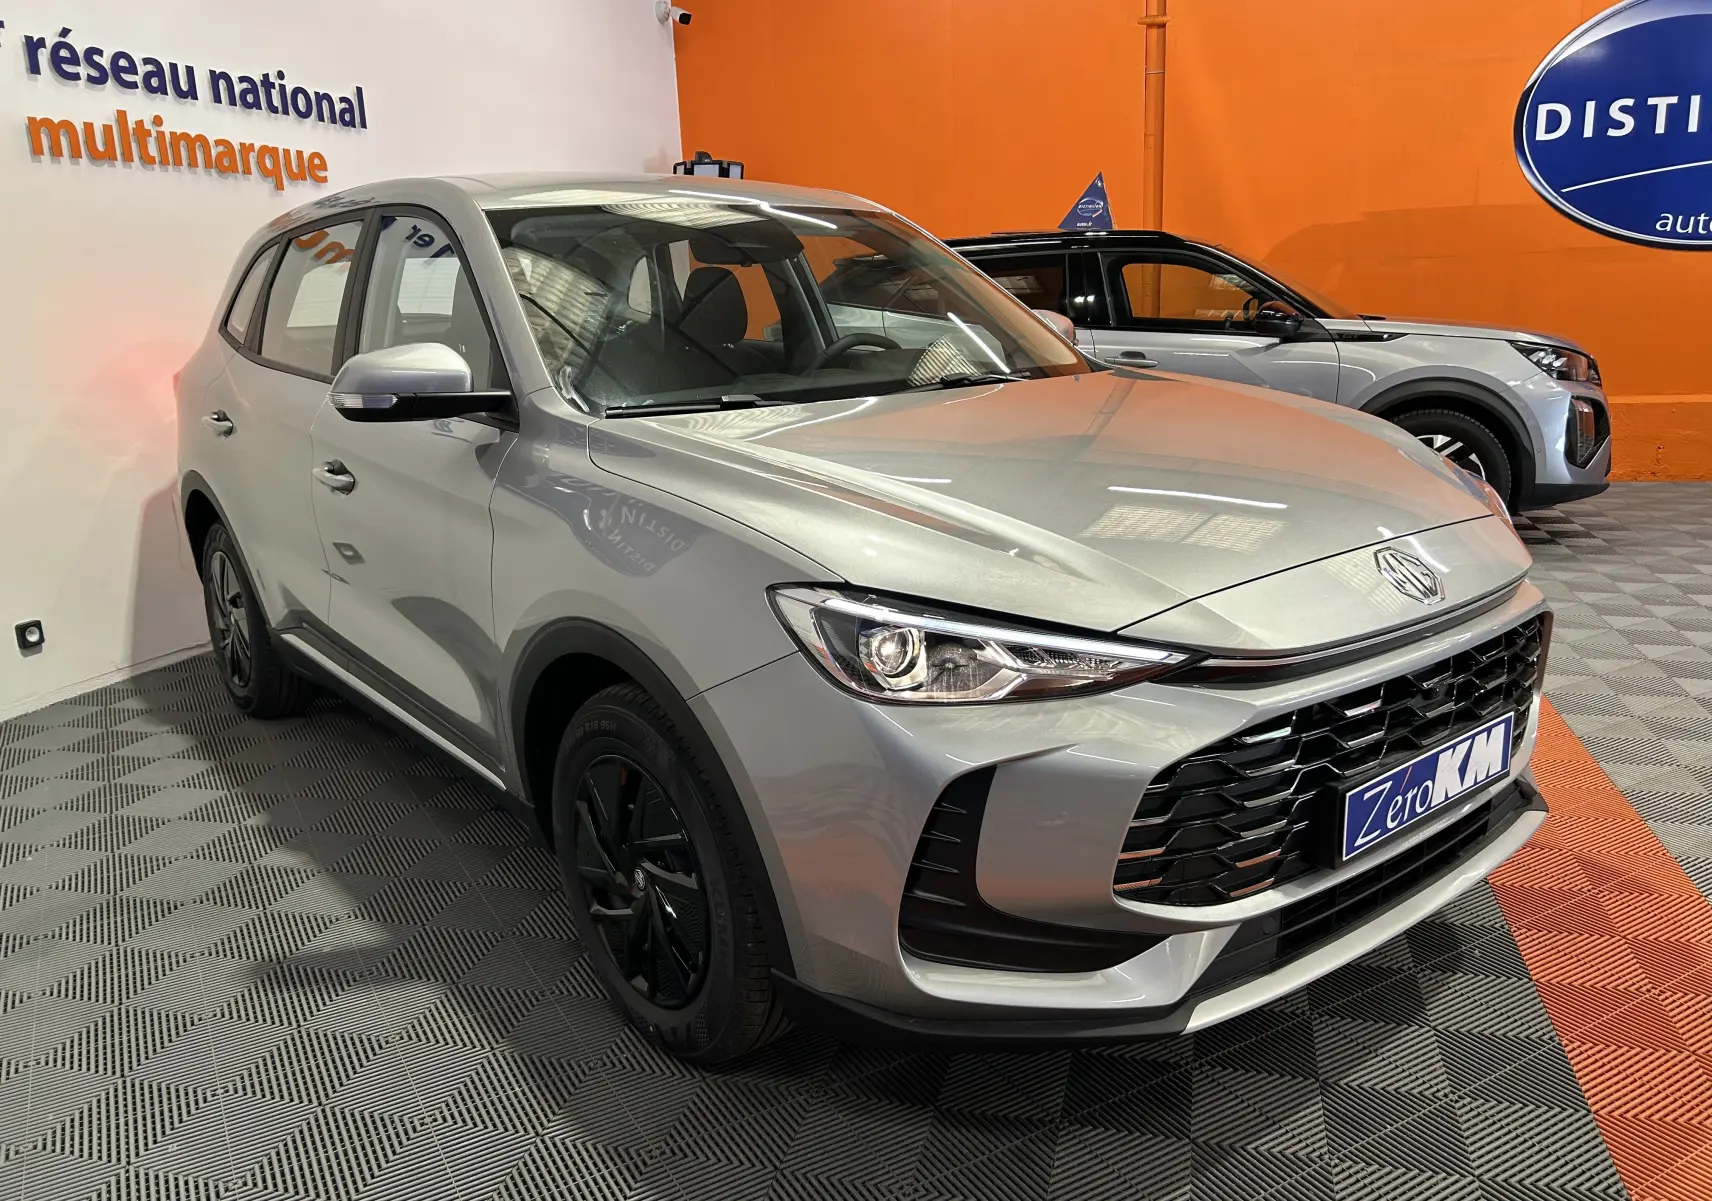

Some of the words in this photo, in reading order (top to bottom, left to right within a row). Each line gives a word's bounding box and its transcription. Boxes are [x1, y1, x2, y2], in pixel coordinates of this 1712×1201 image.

[24, 27, 198, 100] réseau
[208, 70, 367, 129] national
[27, 109, 328, 190] multimarque
[1655, 212, 1712, 234] aut
